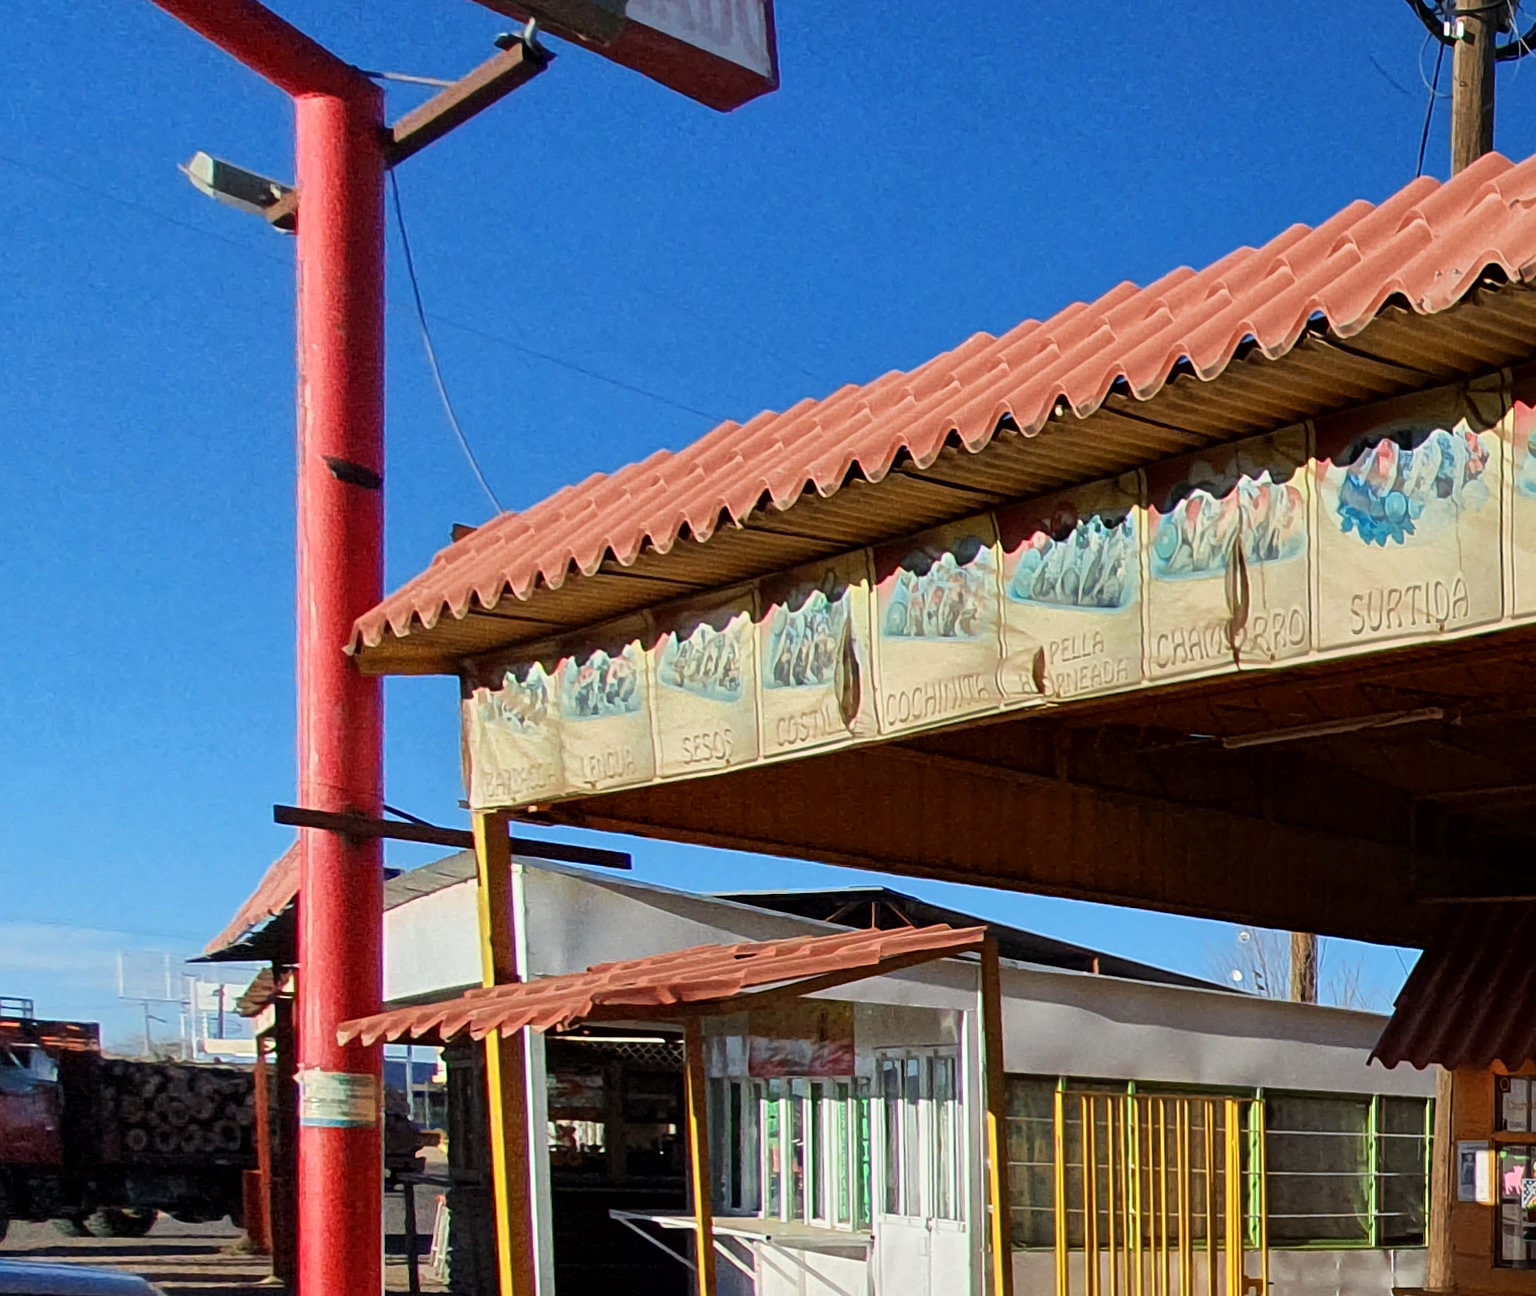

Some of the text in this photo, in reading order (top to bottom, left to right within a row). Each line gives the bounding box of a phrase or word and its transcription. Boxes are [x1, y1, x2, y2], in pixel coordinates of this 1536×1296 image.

[1350, 578, 1470, 636] SURTIDA
[1050, 630, 1105, 665] PELLA
[681, 727, 733, 767] SESOS
